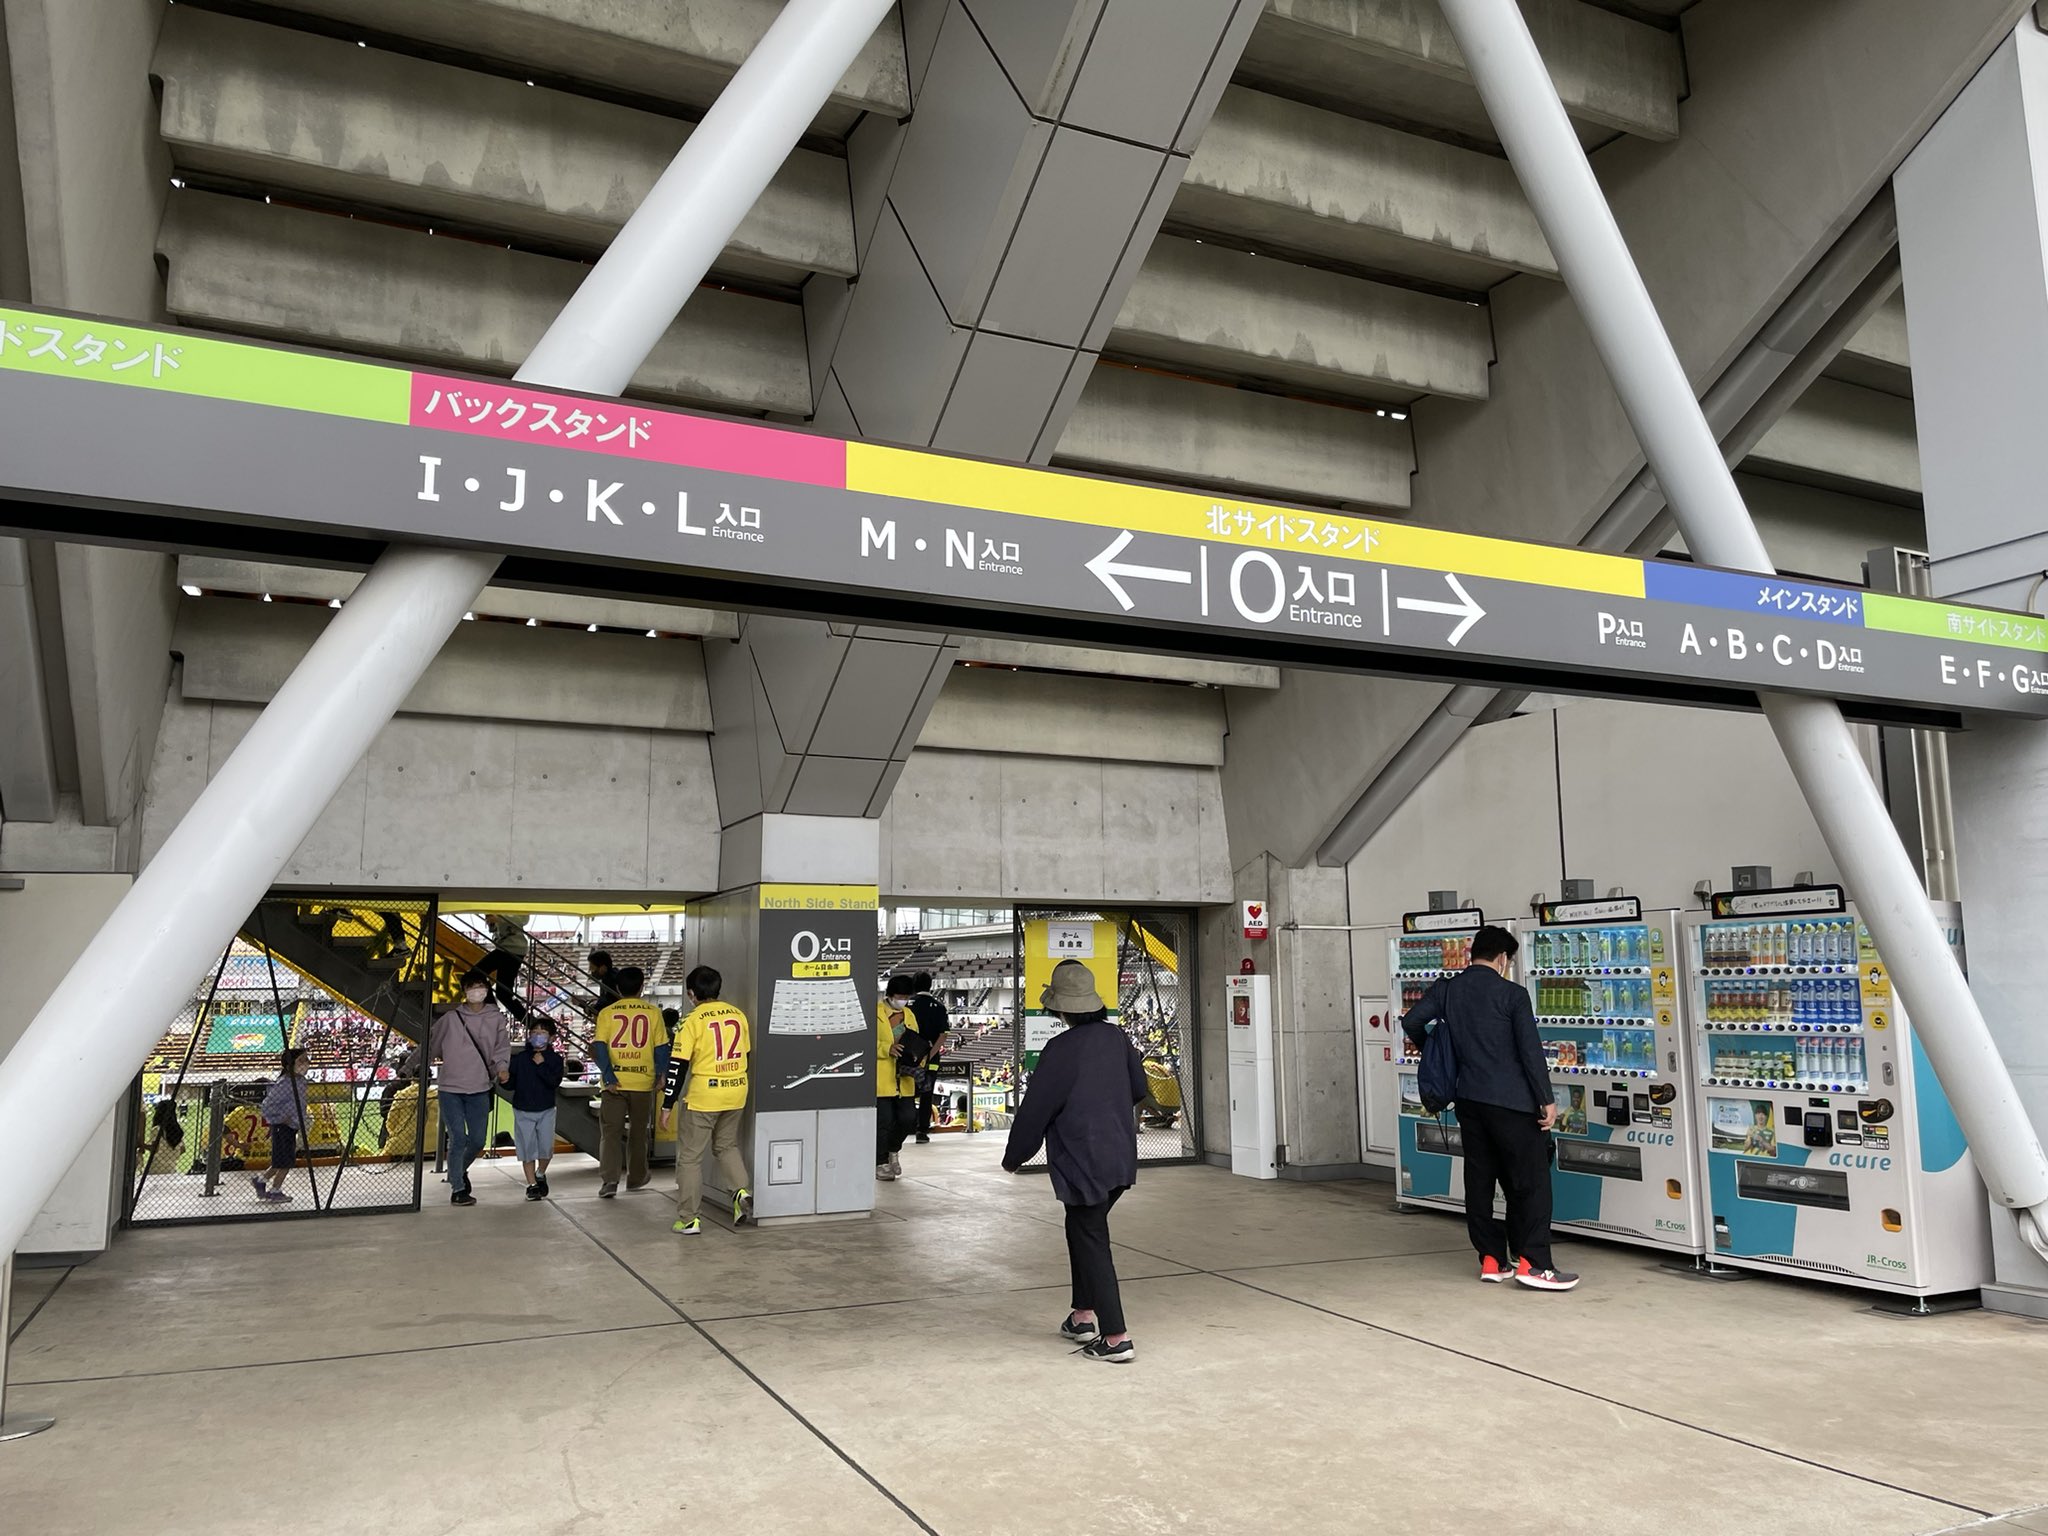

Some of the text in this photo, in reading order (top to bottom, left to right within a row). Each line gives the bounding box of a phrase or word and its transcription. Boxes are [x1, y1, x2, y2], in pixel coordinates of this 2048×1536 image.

[424, 390, 652, 448] バックスタンド
[715, 502, 761, 529] 入口
[712, 526, 765, 543] Entrance
[1205, 505, 1380, 554] 北サイドスタンド
[980, 538, 1020, 562] 入口
[979, 560, 1023, 575] Entrance
[1229, 550, 1356, 624] O 入口
[1757, 586, 1858, 619] メインスタンド
[1289, 603, 1363, 629] Entrance
[1616, 618, 1644, 638] 入口
[1615, 636, 1646, 649] Entrance
[1838, 662, 1865, 674] Entrance
[764, 897, 876, 909] North Side Stand
[1061, 931, 1080, 939] ホーム
[791, 930, 852, 962] O 入口
[821, 952, 852, 961] Entrance
[699, 1008, 741, 1020] JRE MALL
[611, 1014, 649, 1049] 20
[708, 1019, 742, 1061] 12
[618, 1051, 641, 1060] TAKAGI
[715, 1062, 739, 1073] UNITED
[1627, 1130, 1675, 1146] acure
[1828, 1151, 1892, 1171] acure
[1655, 1219, 1686, 1231] JR-Cross
[1866, 1254, 1907, 1270] JR-Cross
